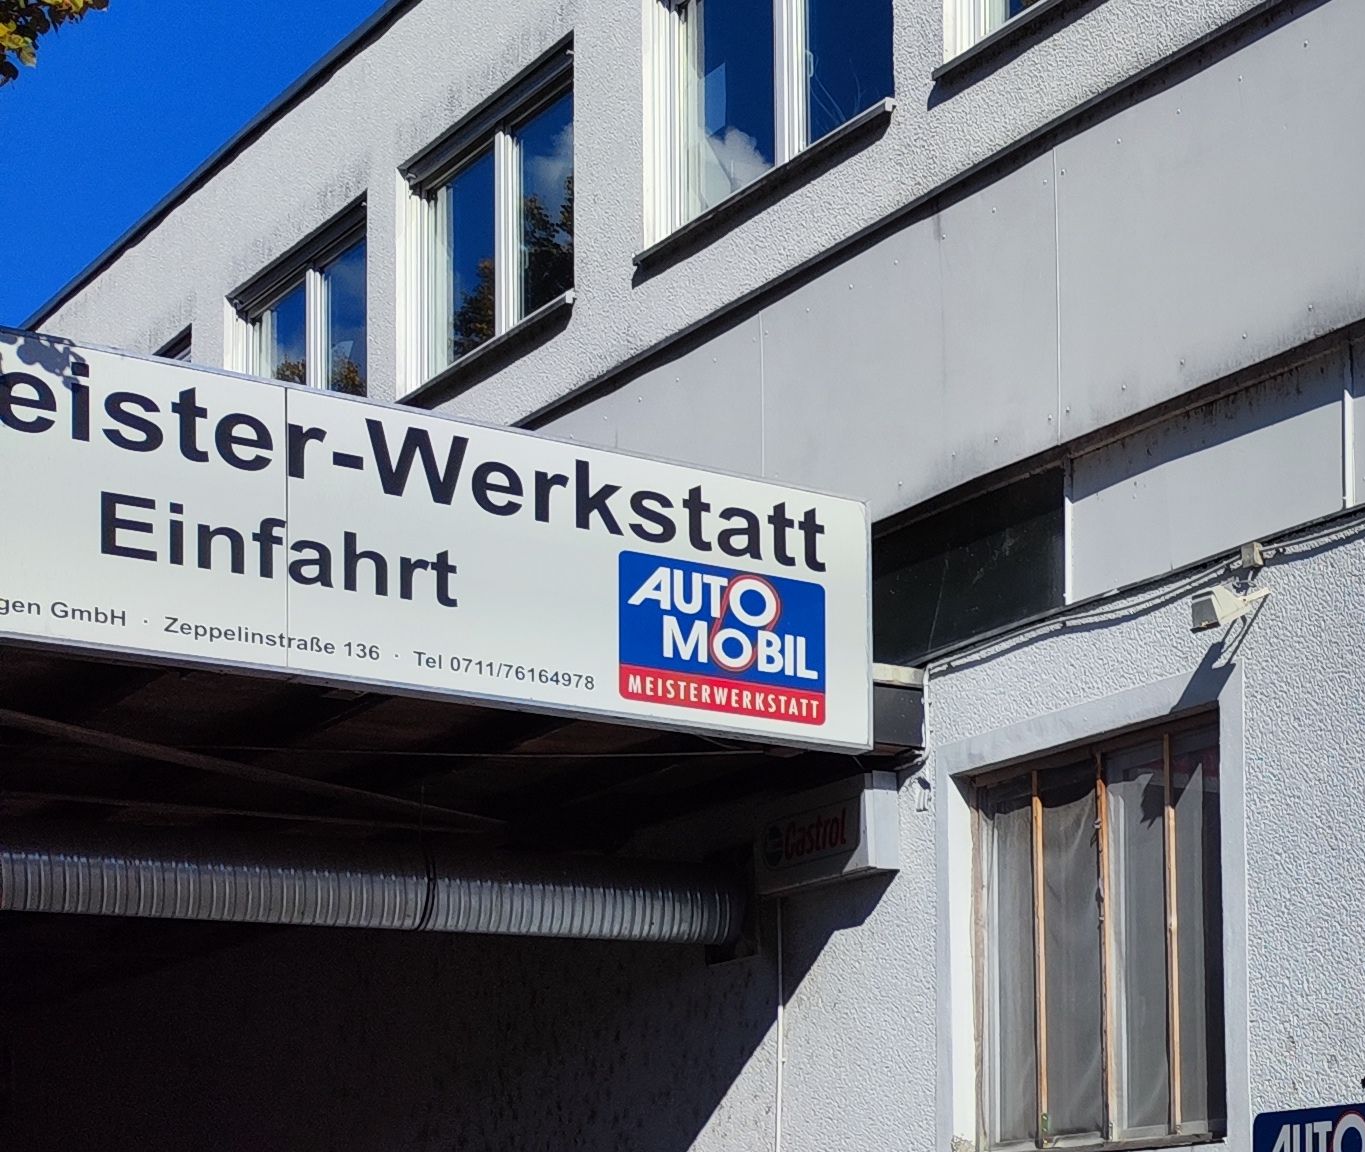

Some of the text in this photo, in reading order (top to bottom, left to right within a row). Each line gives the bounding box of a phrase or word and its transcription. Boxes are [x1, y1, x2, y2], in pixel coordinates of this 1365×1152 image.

[0, 361, 826, 572] eister-Werkstatt
[100, 490, 458, 608] Einfahrt
[627, 566, 777, 627] AUTO
[51, 601, 126, 627] GmbH
[164, 616, 336, 655] Zeppelinstraße
[343, 641, 380, 662] 136
[413, 650, 443, 670] Tel
[450, 656, 596, 691] 0711/76164978
[662, 614, 818, 680] MOBIL
[628, 674, 819, 718] MEISTERWERKSTATT
[784, 807, 847, 860] Castrol
